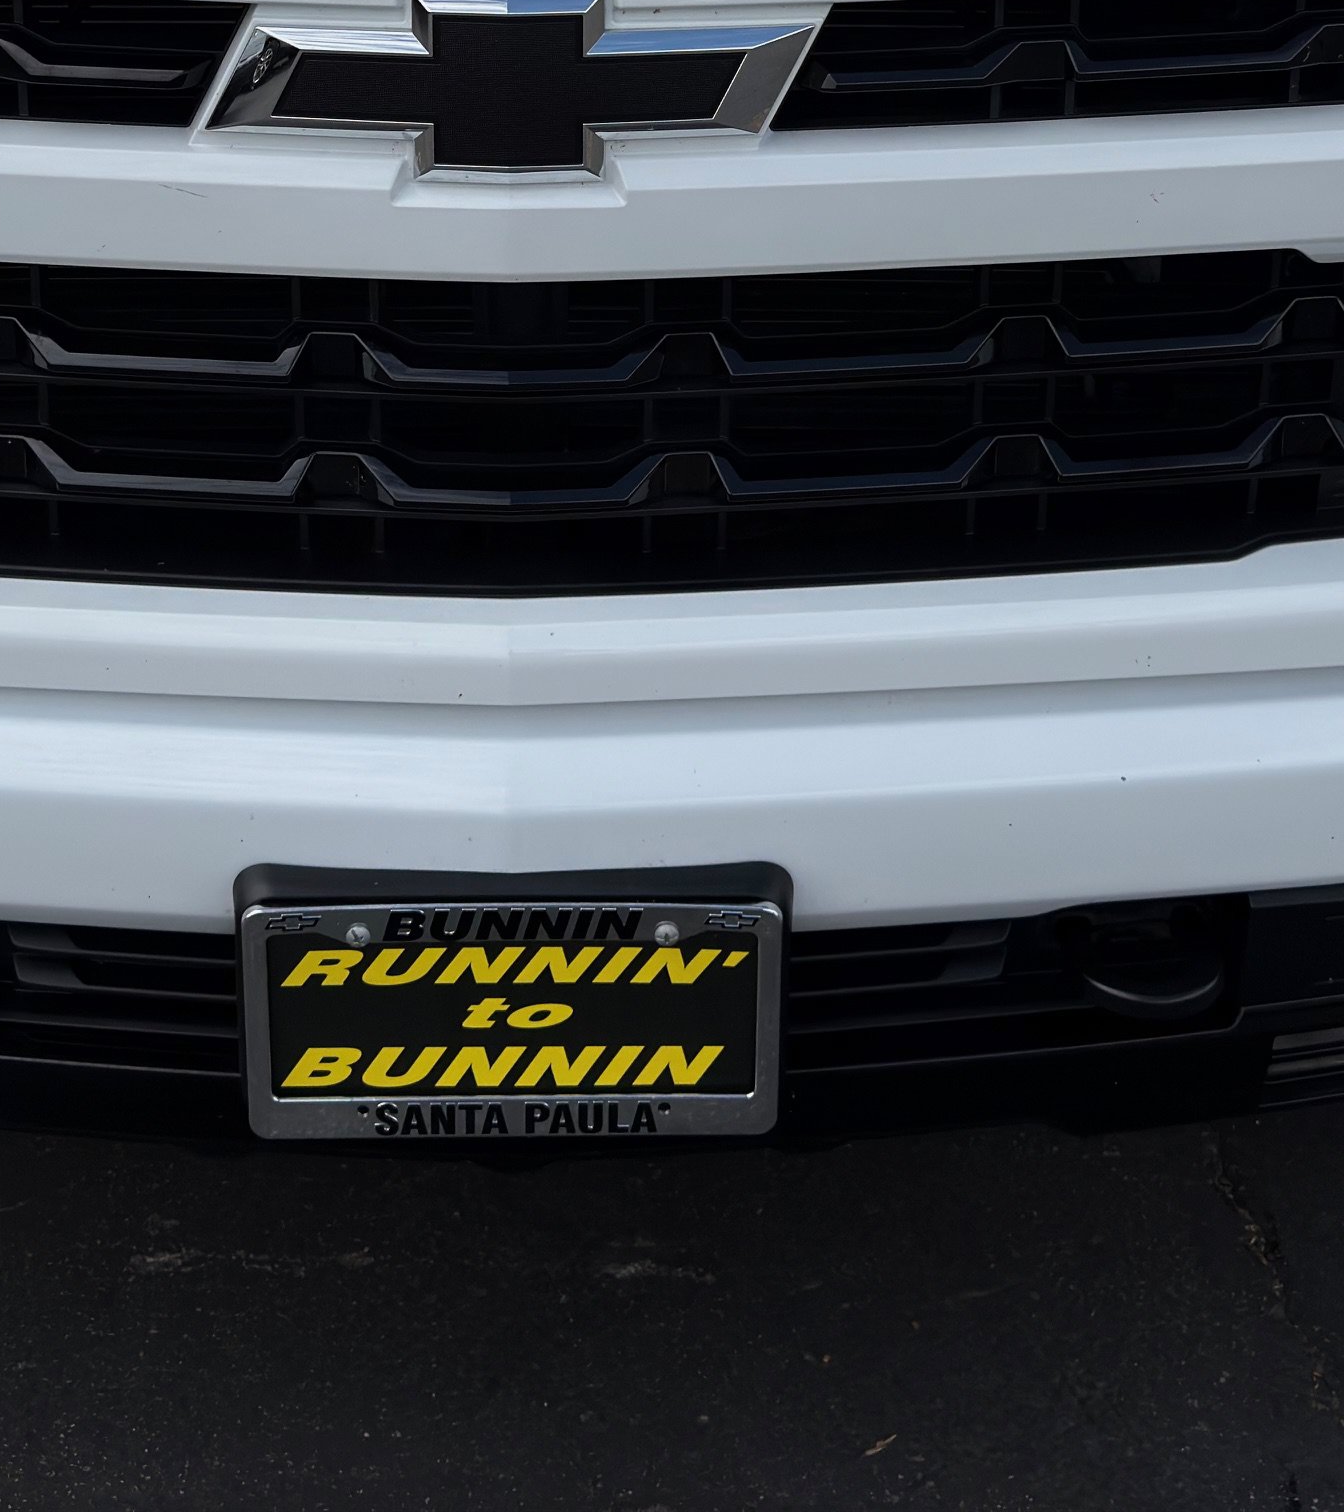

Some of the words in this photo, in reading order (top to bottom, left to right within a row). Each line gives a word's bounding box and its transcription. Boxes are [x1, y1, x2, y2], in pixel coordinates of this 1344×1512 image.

[382, 908, 644, 942] BUNNIN
[280, 946, 750, 987] RUNNIN'
[462, 997, 574, 1029] to
[280, 1045, 726, 1088] BUNNIN
[374, 1101, 509, 1136] SANTA
[524, 1100, 658, 1135] PAULA
